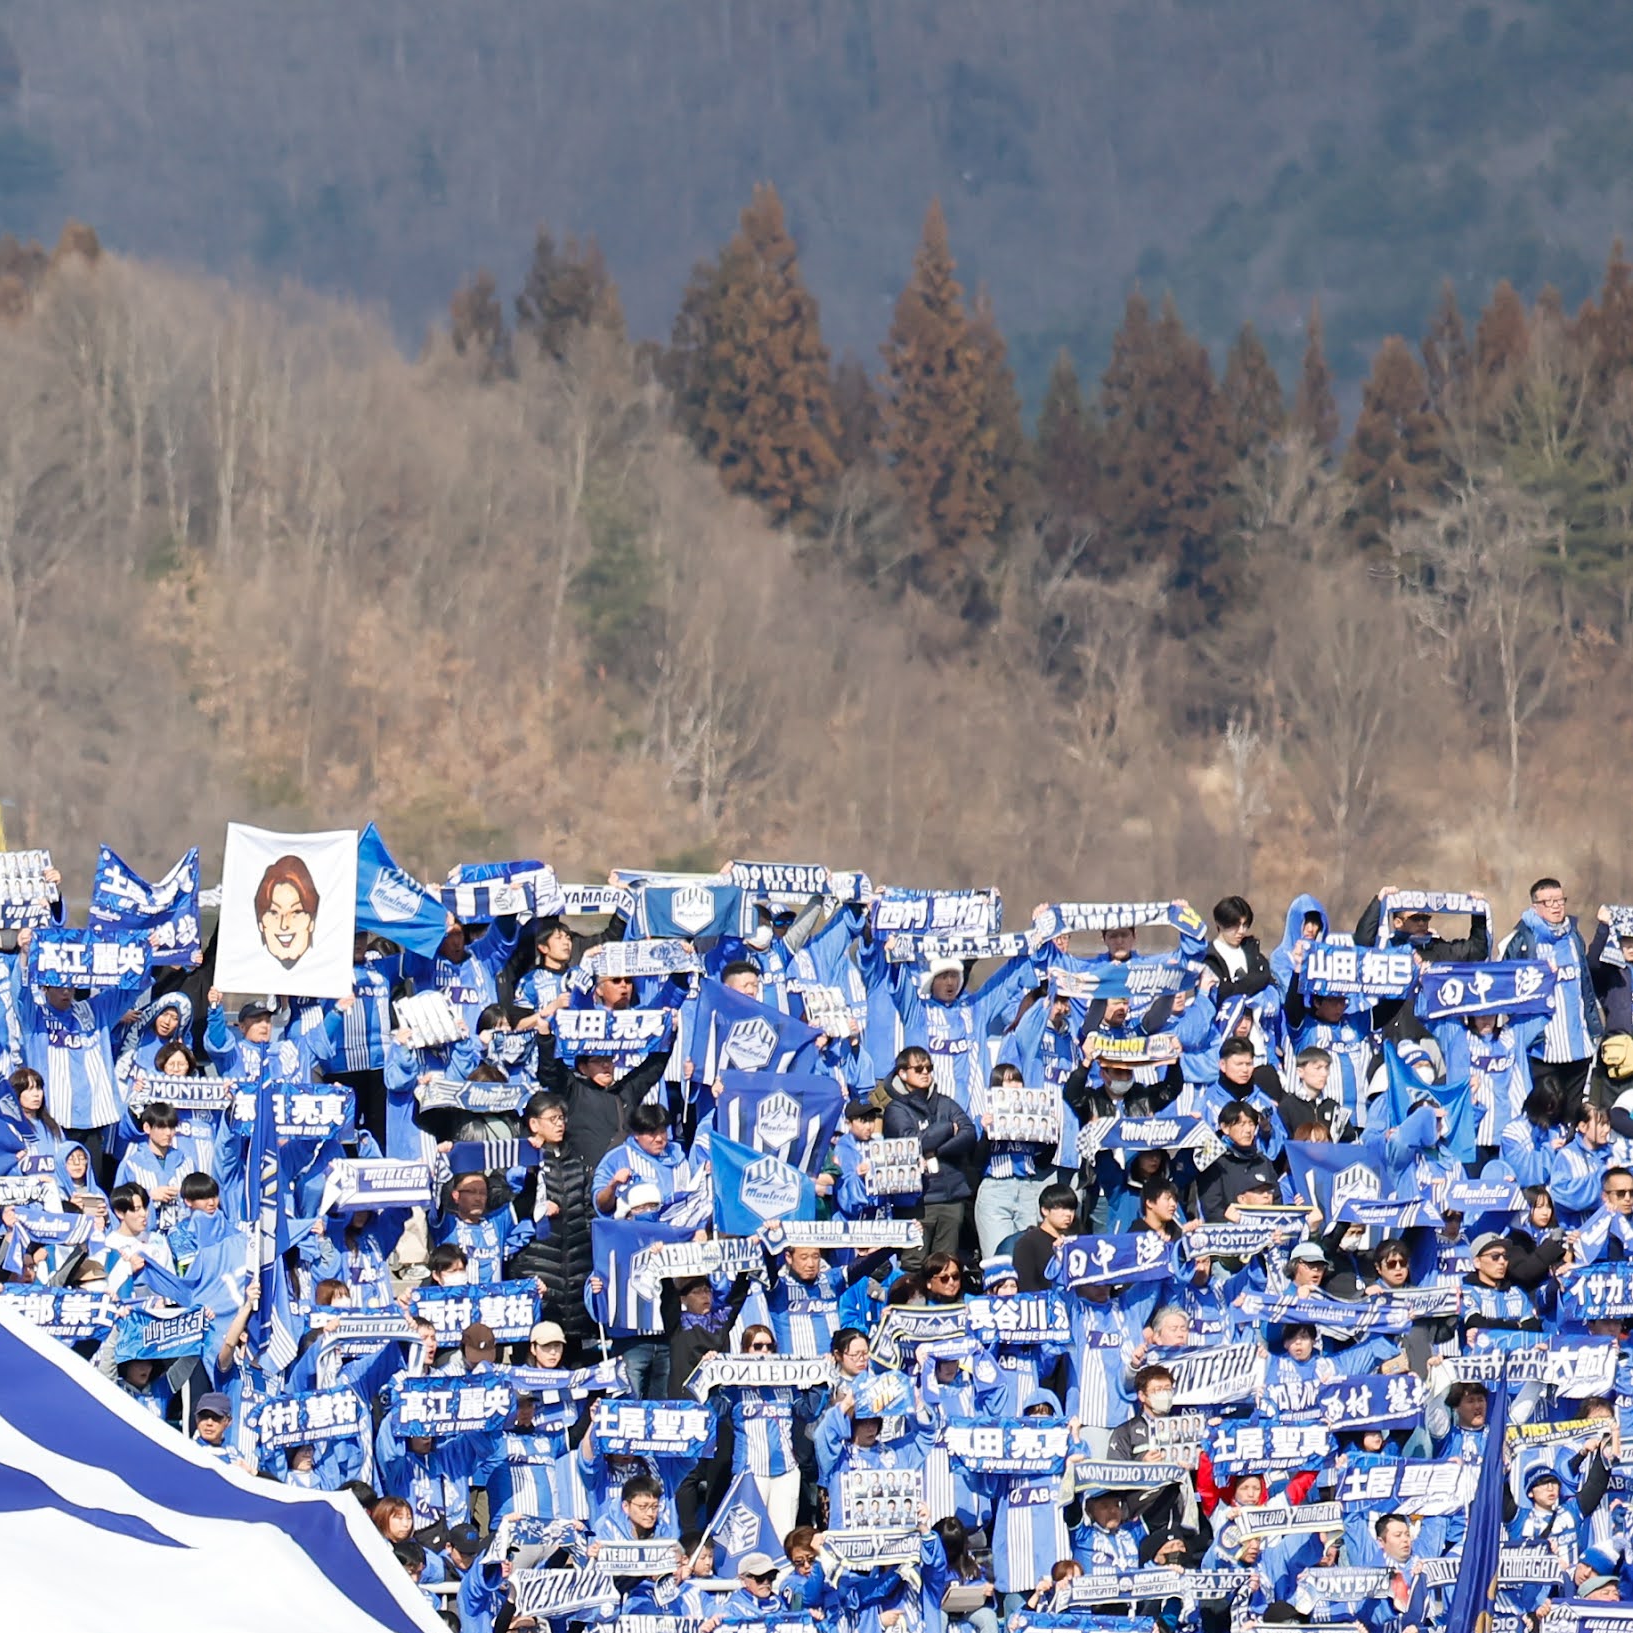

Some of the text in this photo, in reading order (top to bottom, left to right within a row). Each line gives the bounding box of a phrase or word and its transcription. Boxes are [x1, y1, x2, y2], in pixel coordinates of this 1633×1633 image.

[732, 865, 825, 884] MONTEDIO
[564, 890, 633, 909] YAMAGATA
[1308, 949, 1412, 979] 山田拓巳
[847, 1222, 907, 1233] YAMAGATA
[599, 1407, 708, 1440] 土居聖真
[948, 1422, 1068, 1460] 氣田亮真
[1214, 1430, 1330, 1461] 土居聖真
